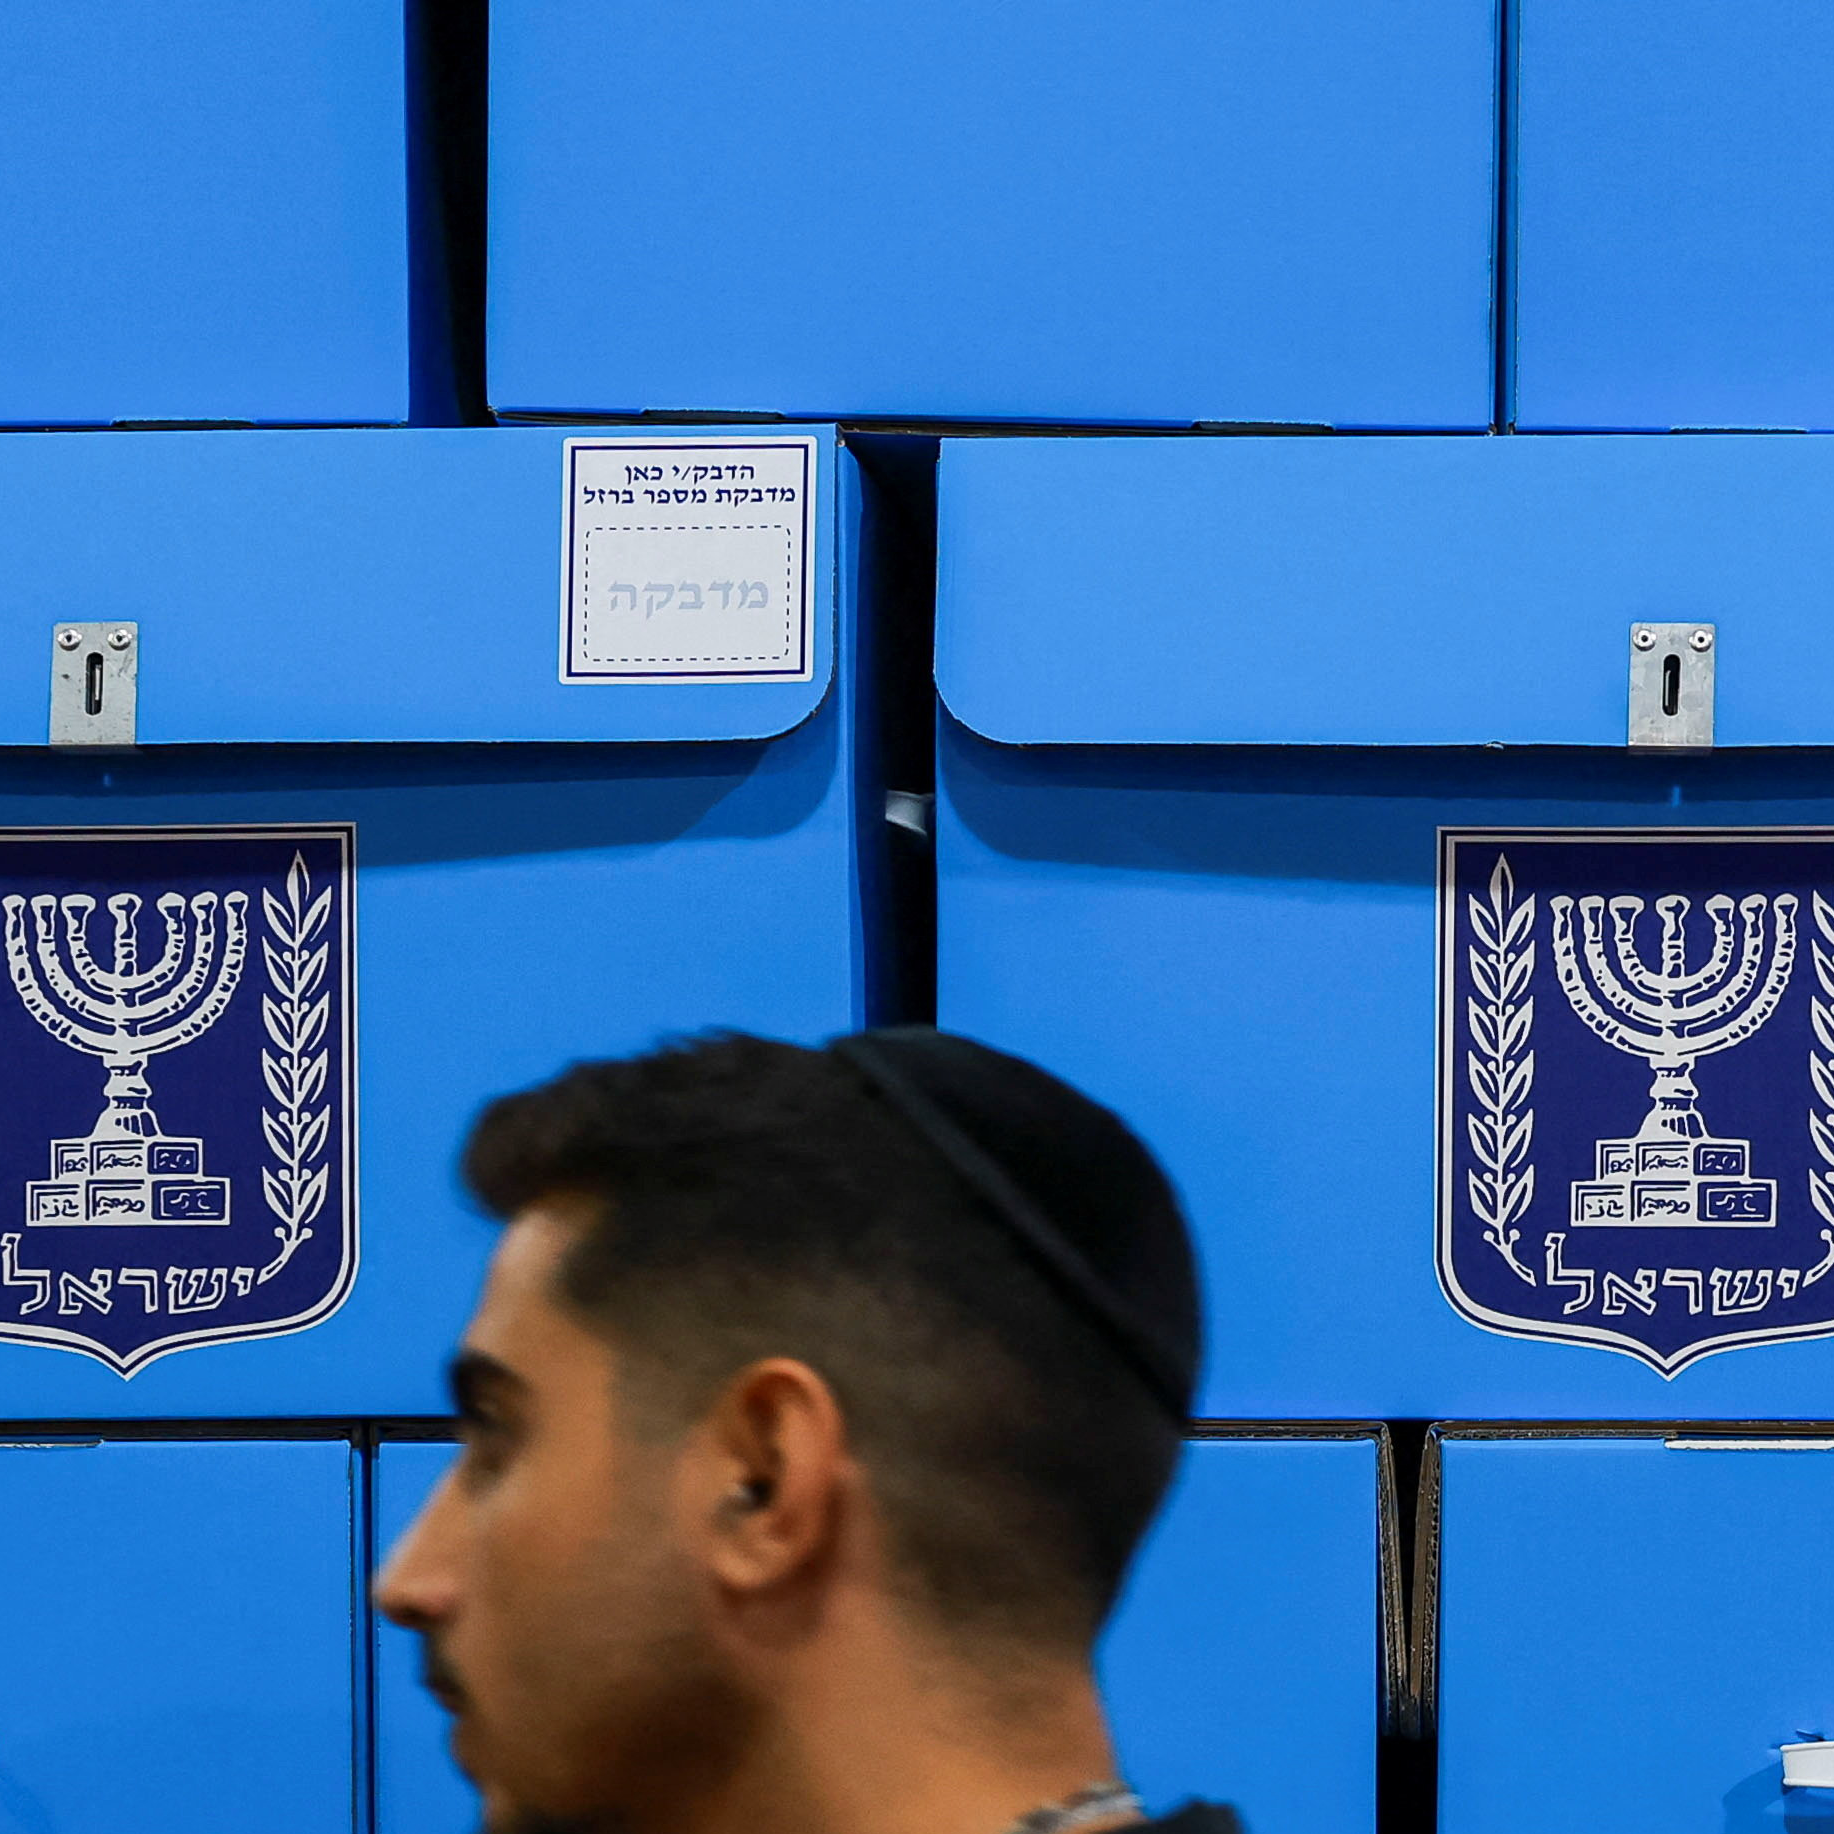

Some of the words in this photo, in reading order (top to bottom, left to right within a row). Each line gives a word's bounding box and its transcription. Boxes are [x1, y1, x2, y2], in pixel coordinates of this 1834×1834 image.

[624, 465, 664, 484] כאן
[673, 465, 755, 484] הדבק/י
[583, 487, 635, 504] ברזל
[643, 488, 708, 504] מספר
[714, 487, 796, 507] מדבקת
[607, 580, 769, 621] מדבקה
[0, 1232, 255, 1315] ישראל
[1544, 1232, 1801, 1316] ישראל
